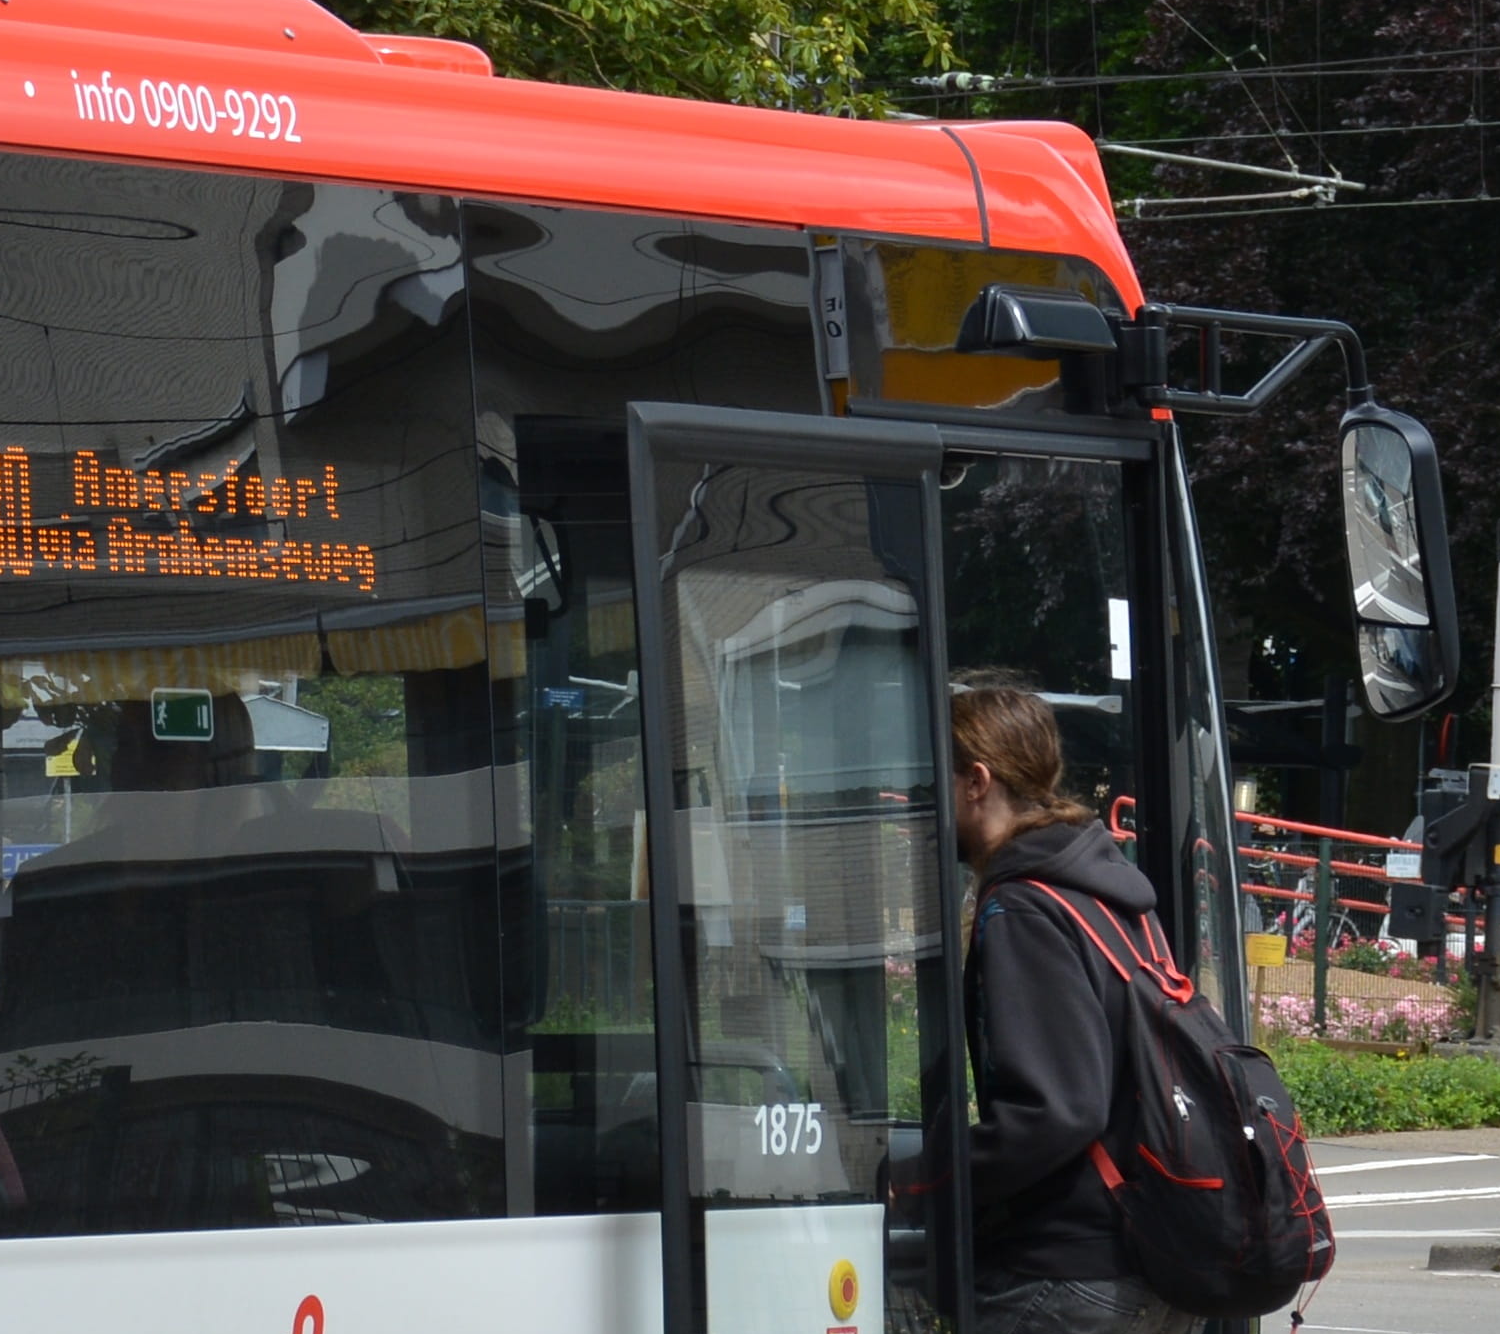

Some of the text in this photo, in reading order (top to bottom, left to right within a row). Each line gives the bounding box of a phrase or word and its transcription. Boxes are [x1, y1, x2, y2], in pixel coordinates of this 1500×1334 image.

[73, 70, 136, 125] info
[140, 77, 302, 144] 0900-9292
[74, 450, 340, 520] Amersfoort
[38, 513, 376, 591] via Arnhemseweg
[754, 1103, 823, 1155] 1875
